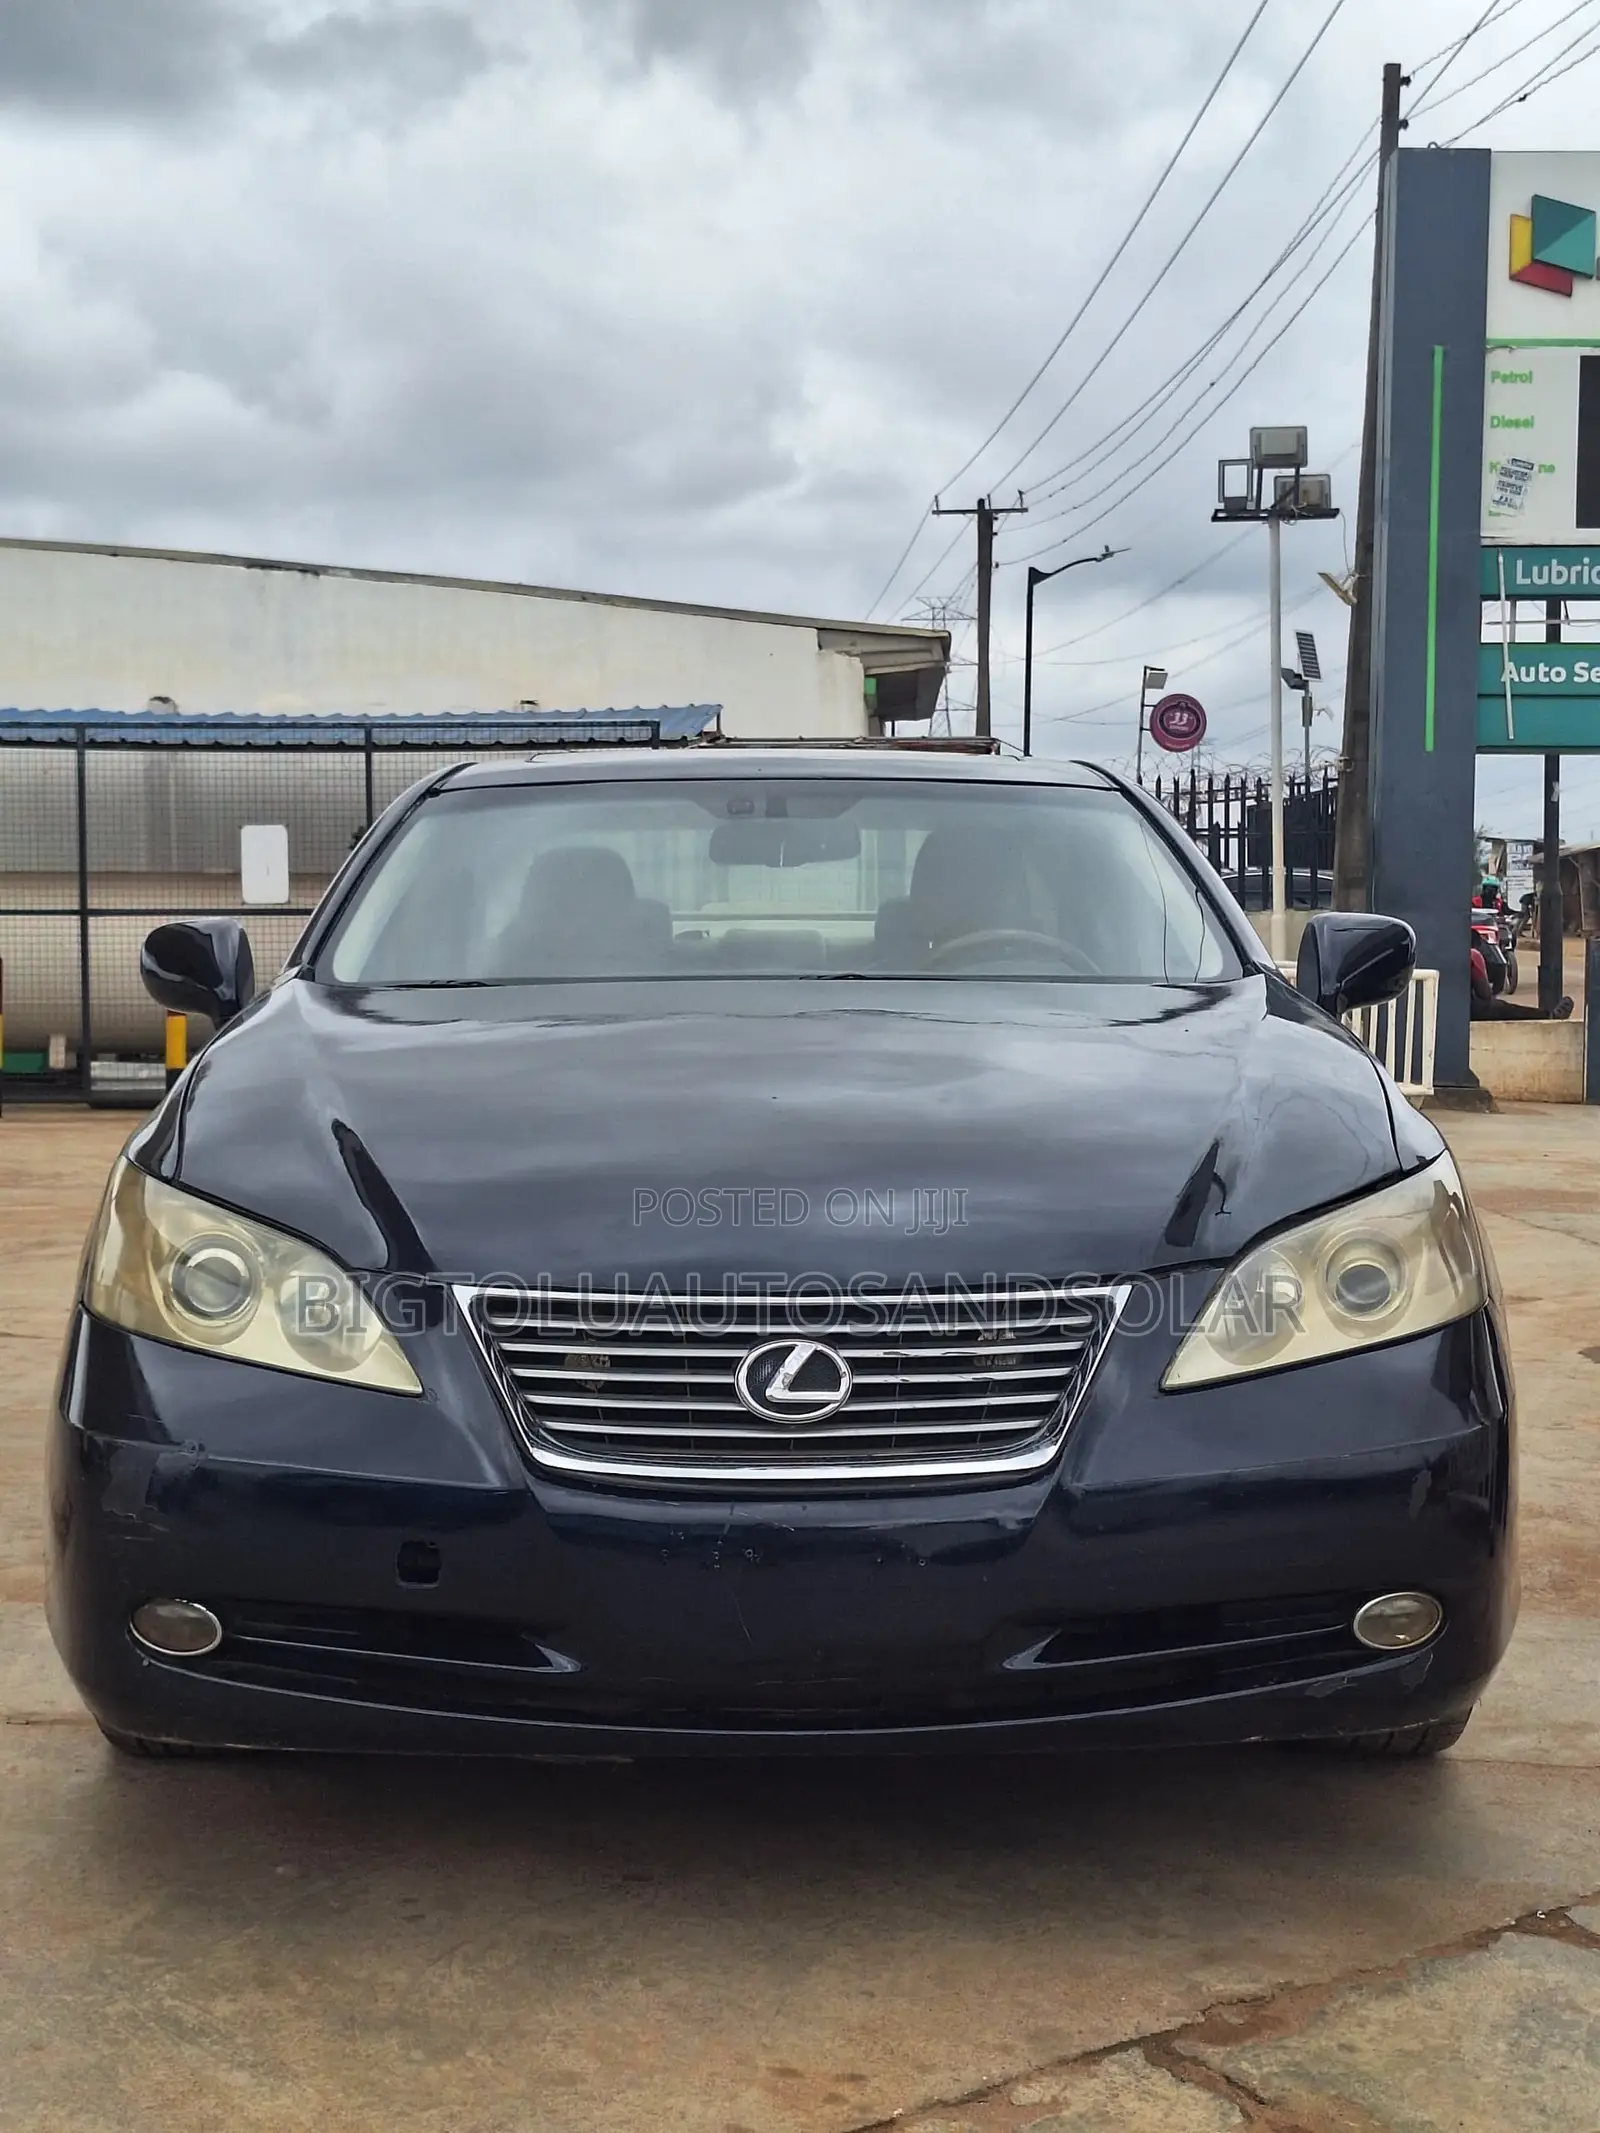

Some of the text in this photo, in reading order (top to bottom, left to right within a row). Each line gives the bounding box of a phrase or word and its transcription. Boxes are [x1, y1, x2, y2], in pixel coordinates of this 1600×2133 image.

[1491, 370, 1533, 384] Petrol
[1490, 415, 1535, 429] Diesel
[1501, 662, 1567, 683] Auto
